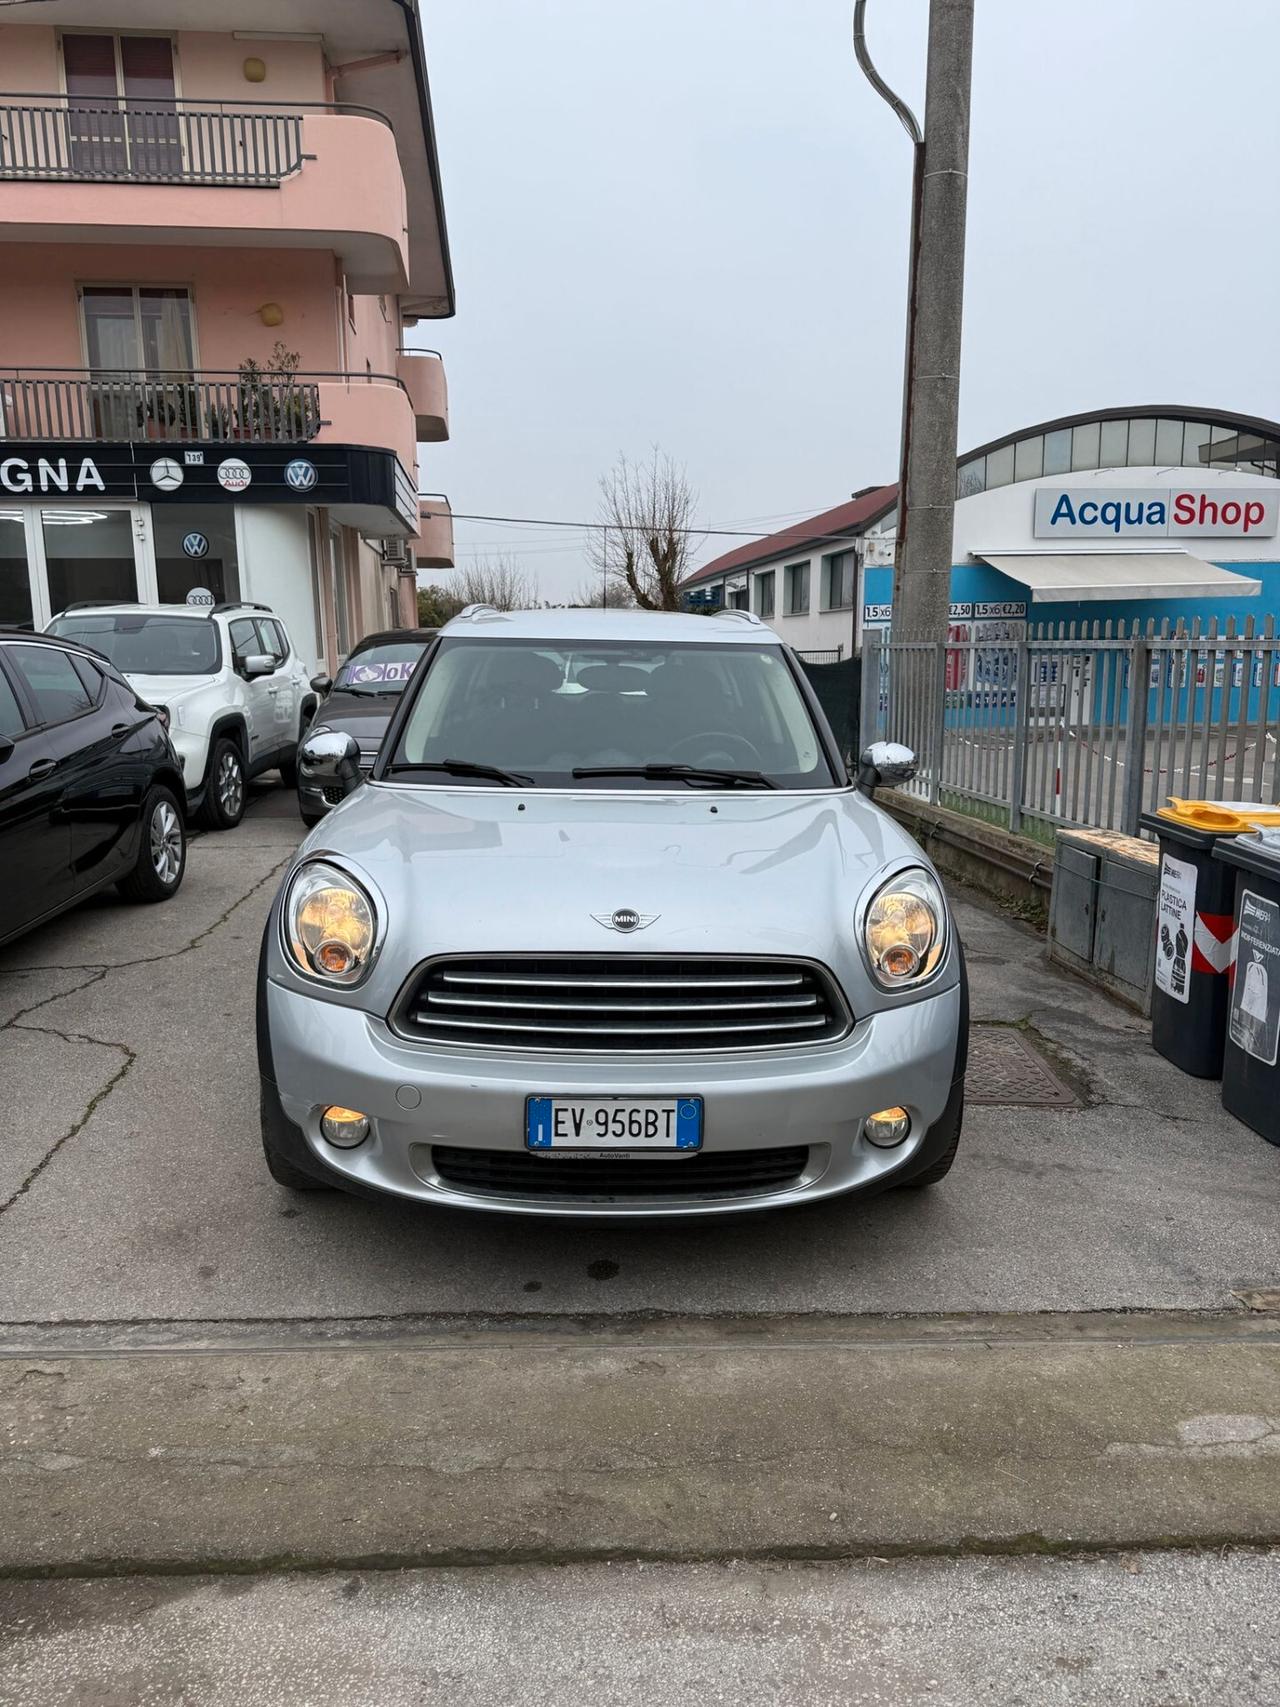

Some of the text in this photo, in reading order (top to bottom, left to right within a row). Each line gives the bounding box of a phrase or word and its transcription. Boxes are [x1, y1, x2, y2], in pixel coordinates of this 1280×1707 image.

[1, 458, 106, 492] GNA
[1050, 493, 1265, 533] Acqua Shop
[1002, 603, 1025, 615] €2,20
[1161, 889, 1187, 911] PLASTICA
[615, 915, 637, 923] MINI
[554, 1108, 676, 1138] EV 956BT
